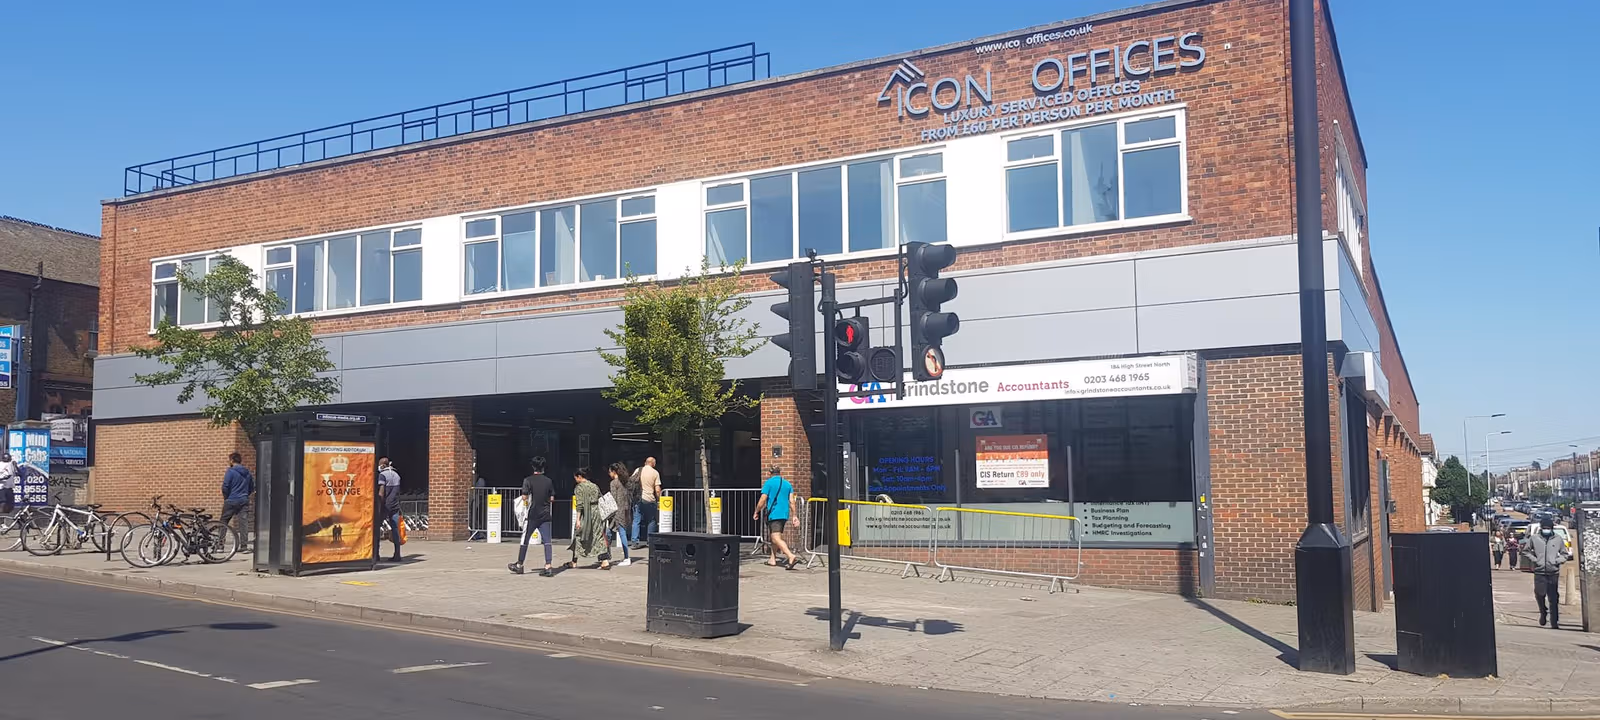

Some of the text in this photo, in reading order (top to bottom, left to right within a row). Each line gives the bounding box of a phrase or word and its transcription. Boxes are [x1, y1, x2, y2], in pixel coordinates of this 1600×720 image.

[897, 32, 1206, 117] ICON OFFICES
[944, 80, 1141, 124] LUXURY SERVICED OFFICES
[921, 89, 1176, 142] FROM £60 PER PERSON PER MONTH
[1120, 363, 1135, 371] High
[903, 378, 989, 398] rindstone
[996, 379, 1070, 393] Accountants
[1083, 375, 1107, 384] 0203
[1109, 374, 1127, 383] 468
[1129, 372, 1150, 382] 1965
[971, 410, 998, 427] GA
[25, 432, 48, 448] Mini
[25, 448, 48, 462] Cabs
[879, 455, 935, 464] OPENING HOURS
[926, 464, 941, 472] 6PM
[979, 469, 1045, 479] CIS Return £89 only
[26, 475, 45, 484] 020
[325, 488, 361, 496] ORANGE
[884, 485, 930, 493] Appointments
[930, 484, 947, 493] Only
[1092, 522, 1122, 530] Budgeting
